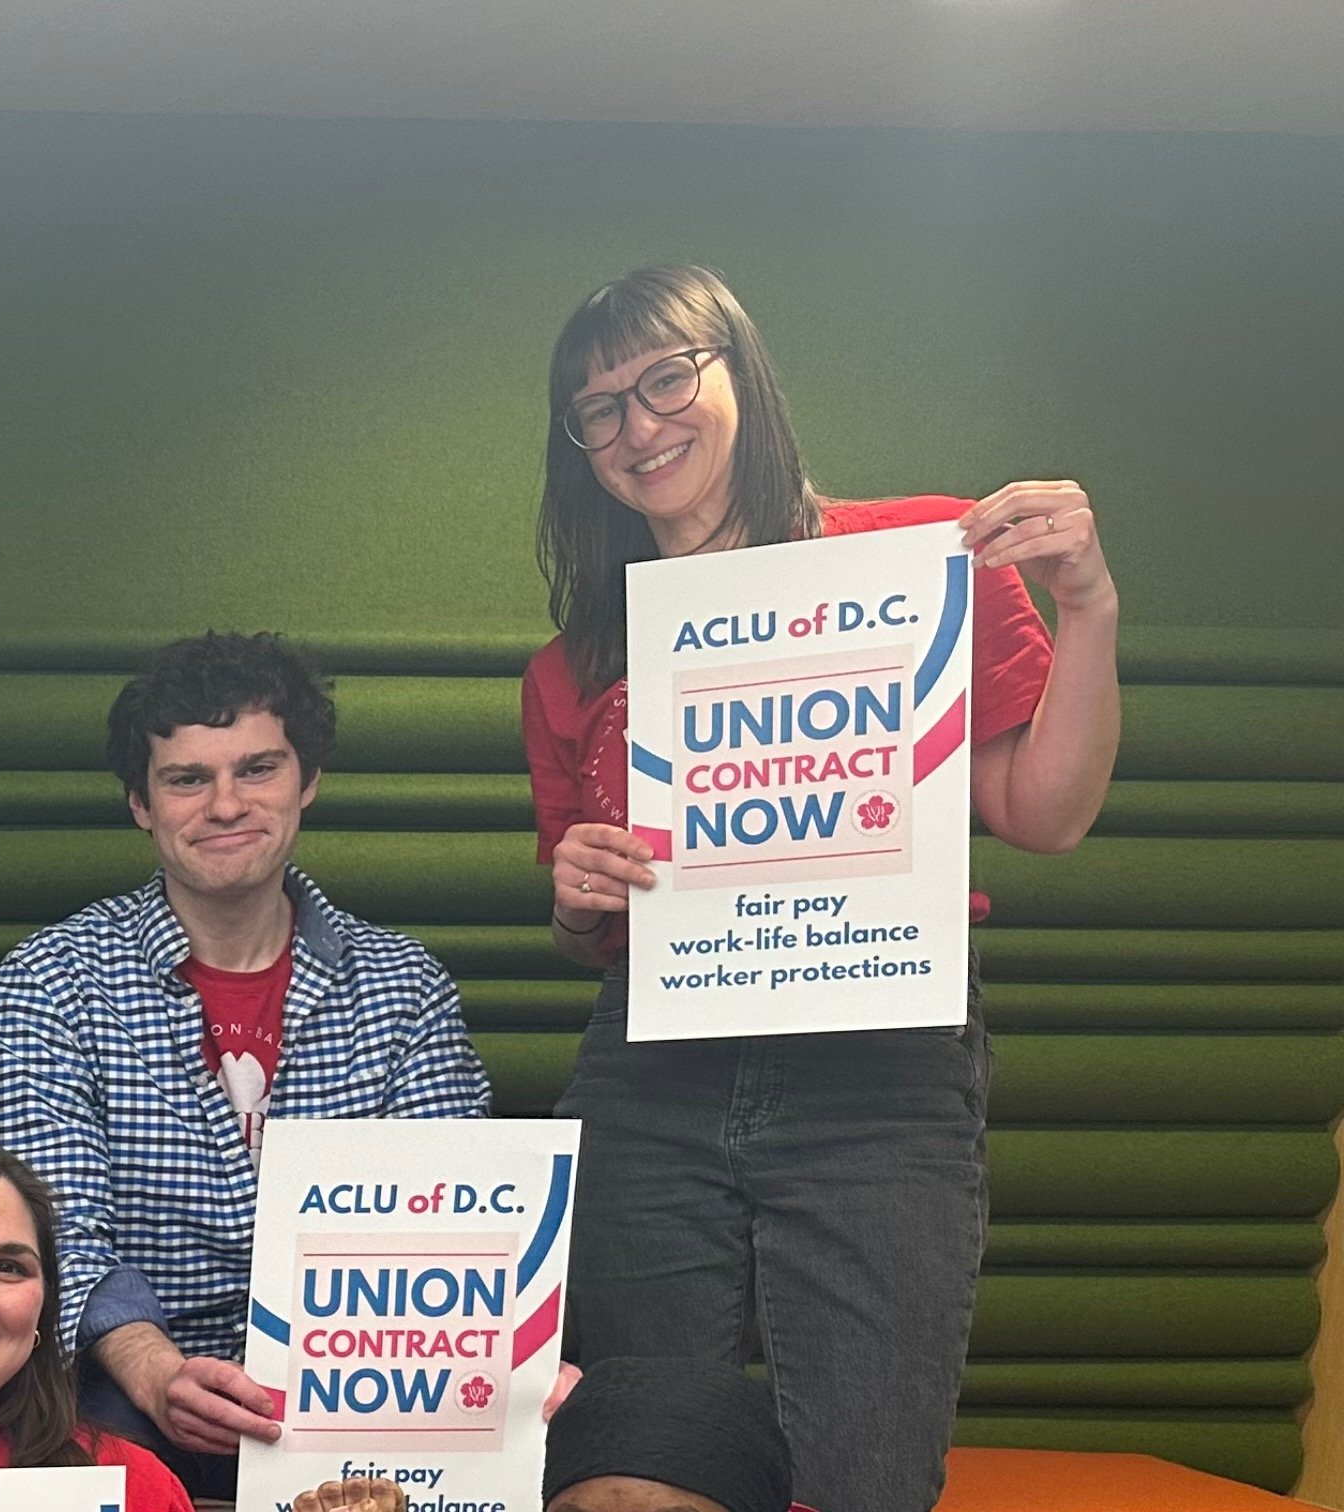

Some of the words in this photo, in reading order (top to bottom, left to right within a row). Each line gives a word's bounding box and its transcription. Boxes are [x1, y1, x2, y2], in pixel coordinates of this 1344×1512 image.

[673, 611, 777, 653] ACLU
[788, 603, 829, 638] of
[839, 595, 919, 632] D.C.
[684, 682, 902, 754] UNION
[686, 746, 898, 794] CONTRACT
[594, 784, 626, 822] NEW
[686, 791, 846, 850] NOW
[736, 894, 786, 918] fair
[794, 896, 848, 920] pay
[670, 926, 798, 956] work-life
[807, 922, 919, 947] balance
[660, 965, 763, 990] worker
[771, 956, 932, 991] protections
[299, 1184, 398, 1215] ACLU
[408, 1183, 447, 1214] of
[453, 1184, 525, 1214] D.C.
[304, 1268, 506, 1318] UNION
[303, 1329, 500, 1359] CONTRACT
[299, 1368, 452, 1414] NOW
[394, 1468, 443, 1488] pay
